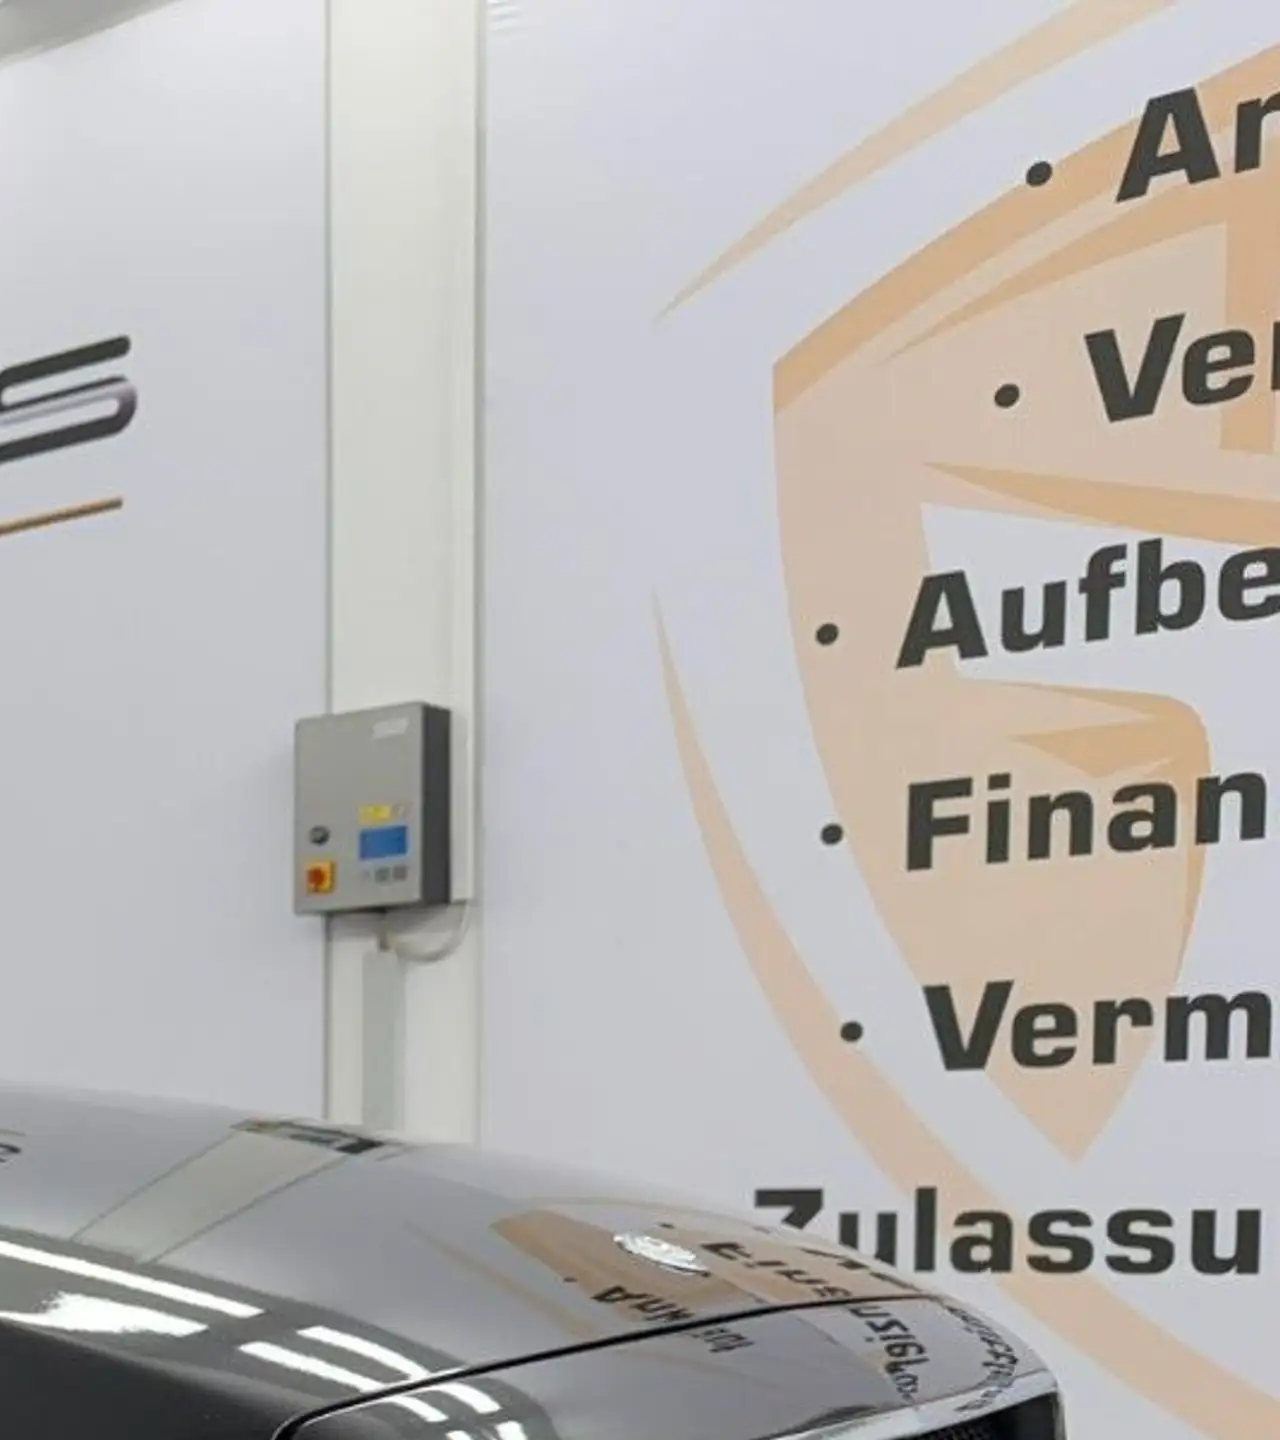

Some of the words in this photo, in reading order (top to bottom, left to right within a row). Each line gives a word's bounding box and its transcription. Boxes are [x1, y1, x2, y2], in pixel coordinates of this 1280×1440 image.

[1084, 313, 1280, 423] Ve
[896, 537, 1280, 669] Aufbe
[906, 772, 1268, 872] Finan
[923, 980, 1273, 1071] Verm
